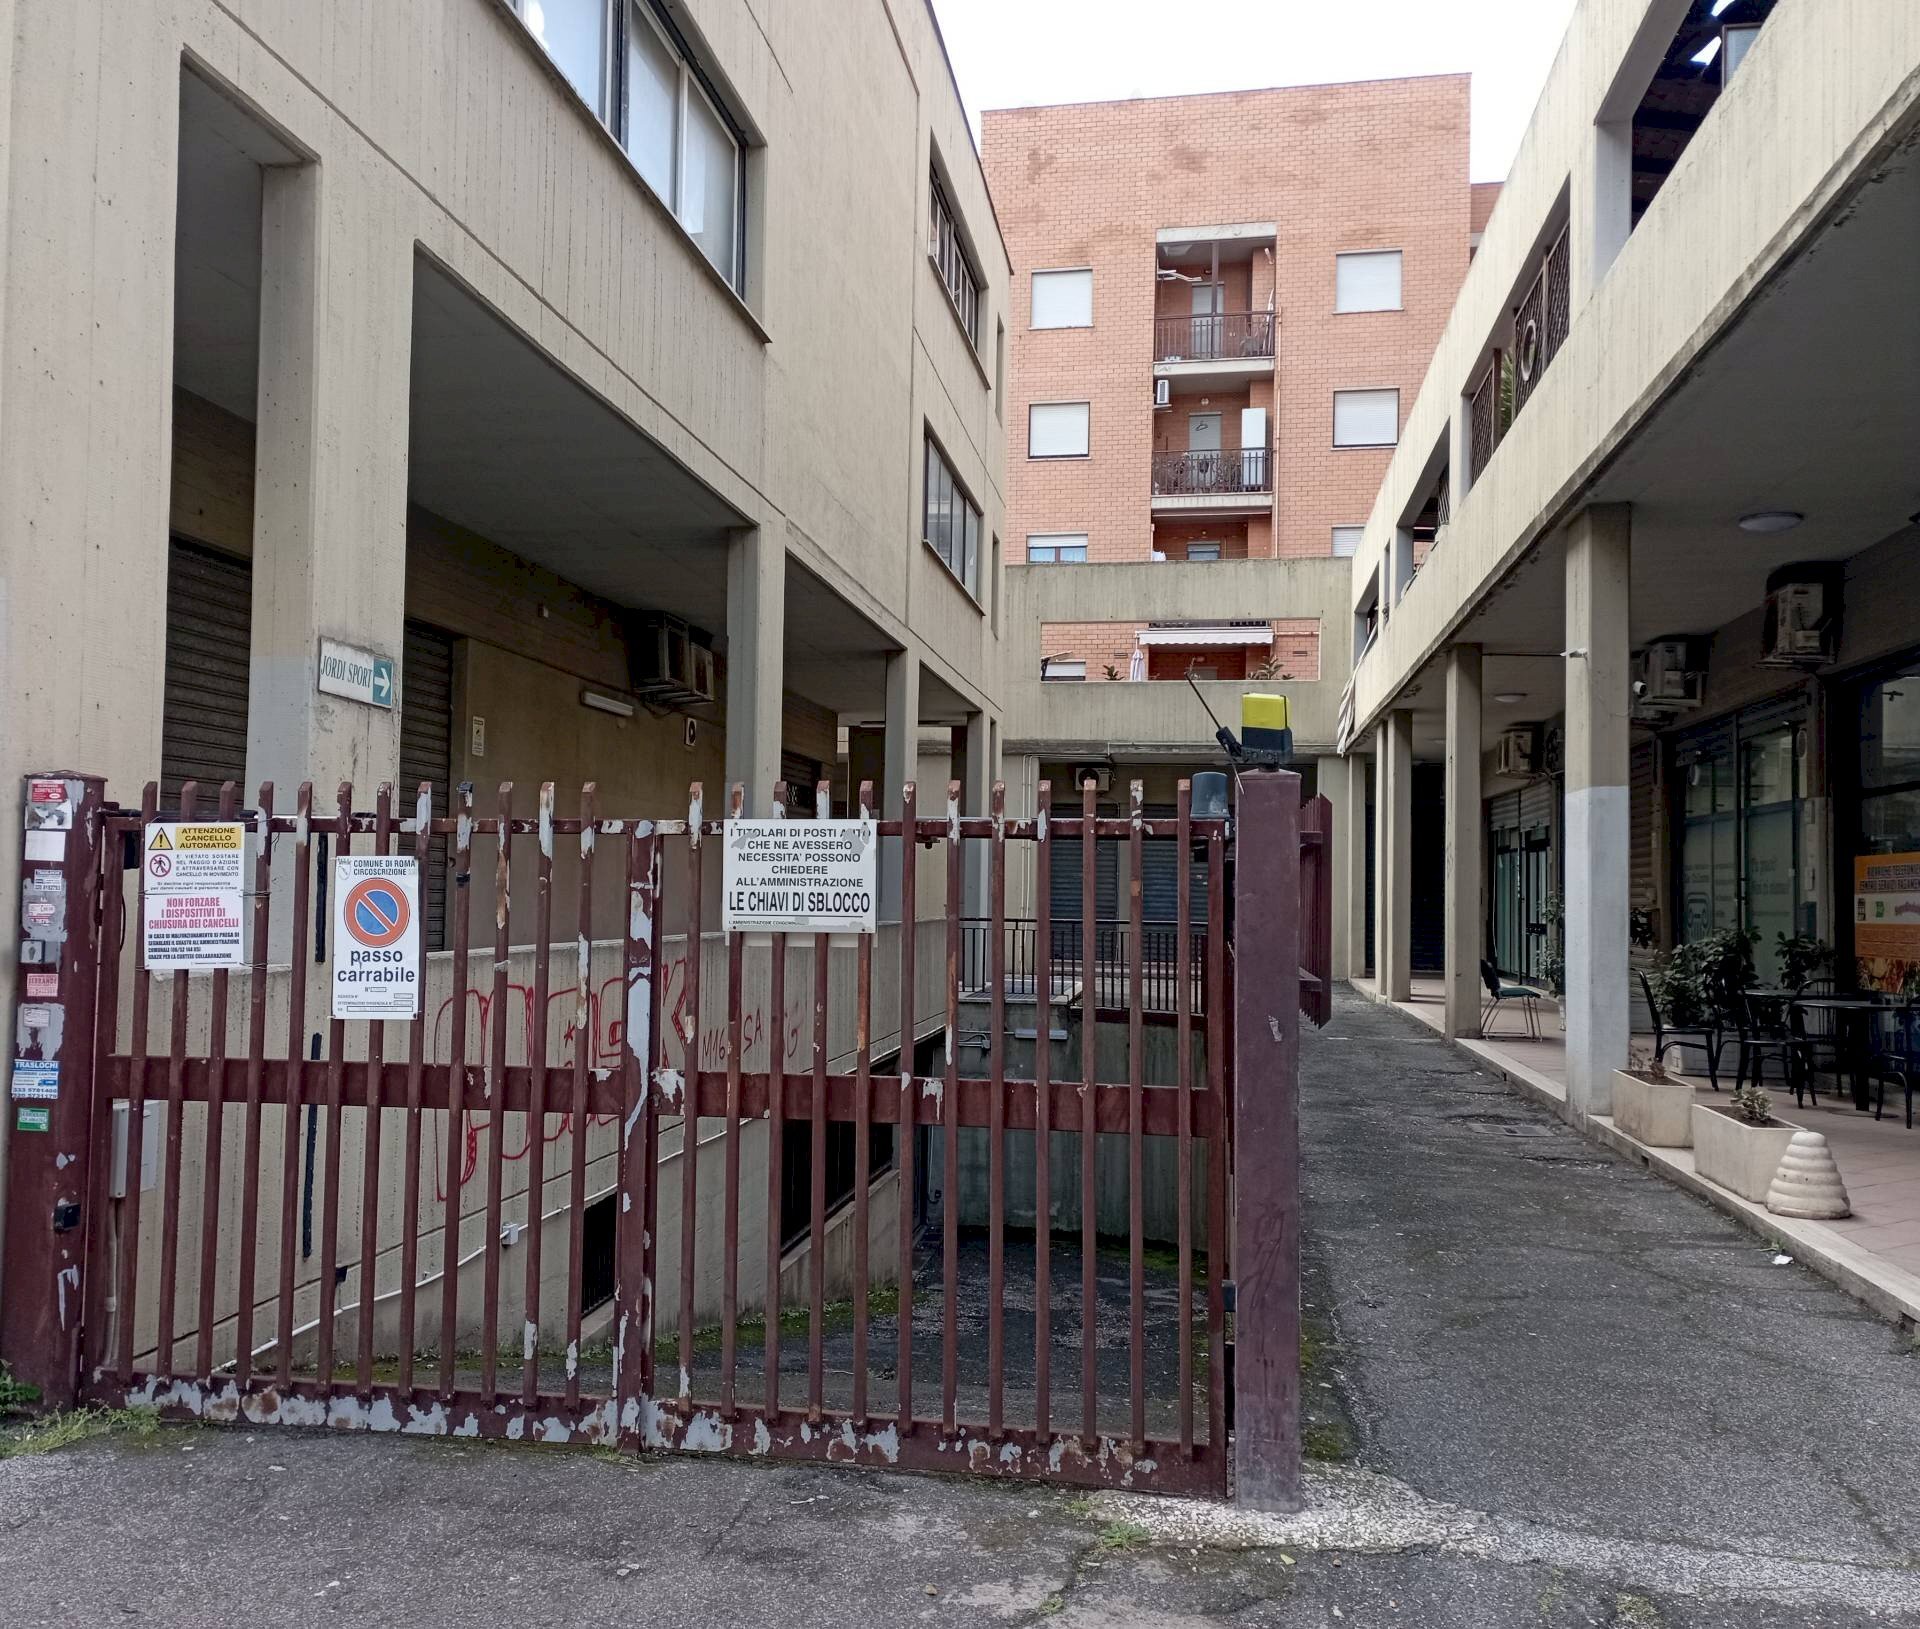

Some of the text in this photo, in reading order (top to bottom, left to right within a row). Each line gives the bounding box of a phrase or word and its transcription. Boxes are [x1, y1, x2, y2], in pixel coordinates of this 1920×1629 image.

[320, 655, 373, 689] JORDI SPORT
[730, 828, 733, 837] I
[736, 828, 786, 838] TITOLARI
[789, 828, 800, 838] DI
[803, 828, 837, 837] POSTI
[747, 840, 853, 850] CHE NE AVESSERO
[738, 852, 861, 863] NECESSITA' POSSONO
[353, 859, 416, 868] COMUNE DI ROMA
[353, 868, 407, 876] CIRCOSCRIZIONE
[771, 865, 829, 875] CHIEDERE
[735, 877, 864, 888] ALL'AMMINISTRAZIONE
[166, 897, 220, 908] NON FORZARE
[729, 891, 871, 913] LE CHIAVI DI SBLOCCO
[166, 908, 215, 919] DISPOSITIVI
[217, 908, 226, 917] DI
[149, 917, 239, 929] CHIUSURA DEI CANCELLI
[350, 950, 403, 967] passo
[337, 966, 415, 983] carrabile
[15, 1061, 58, 1069] TRASLOCHI
